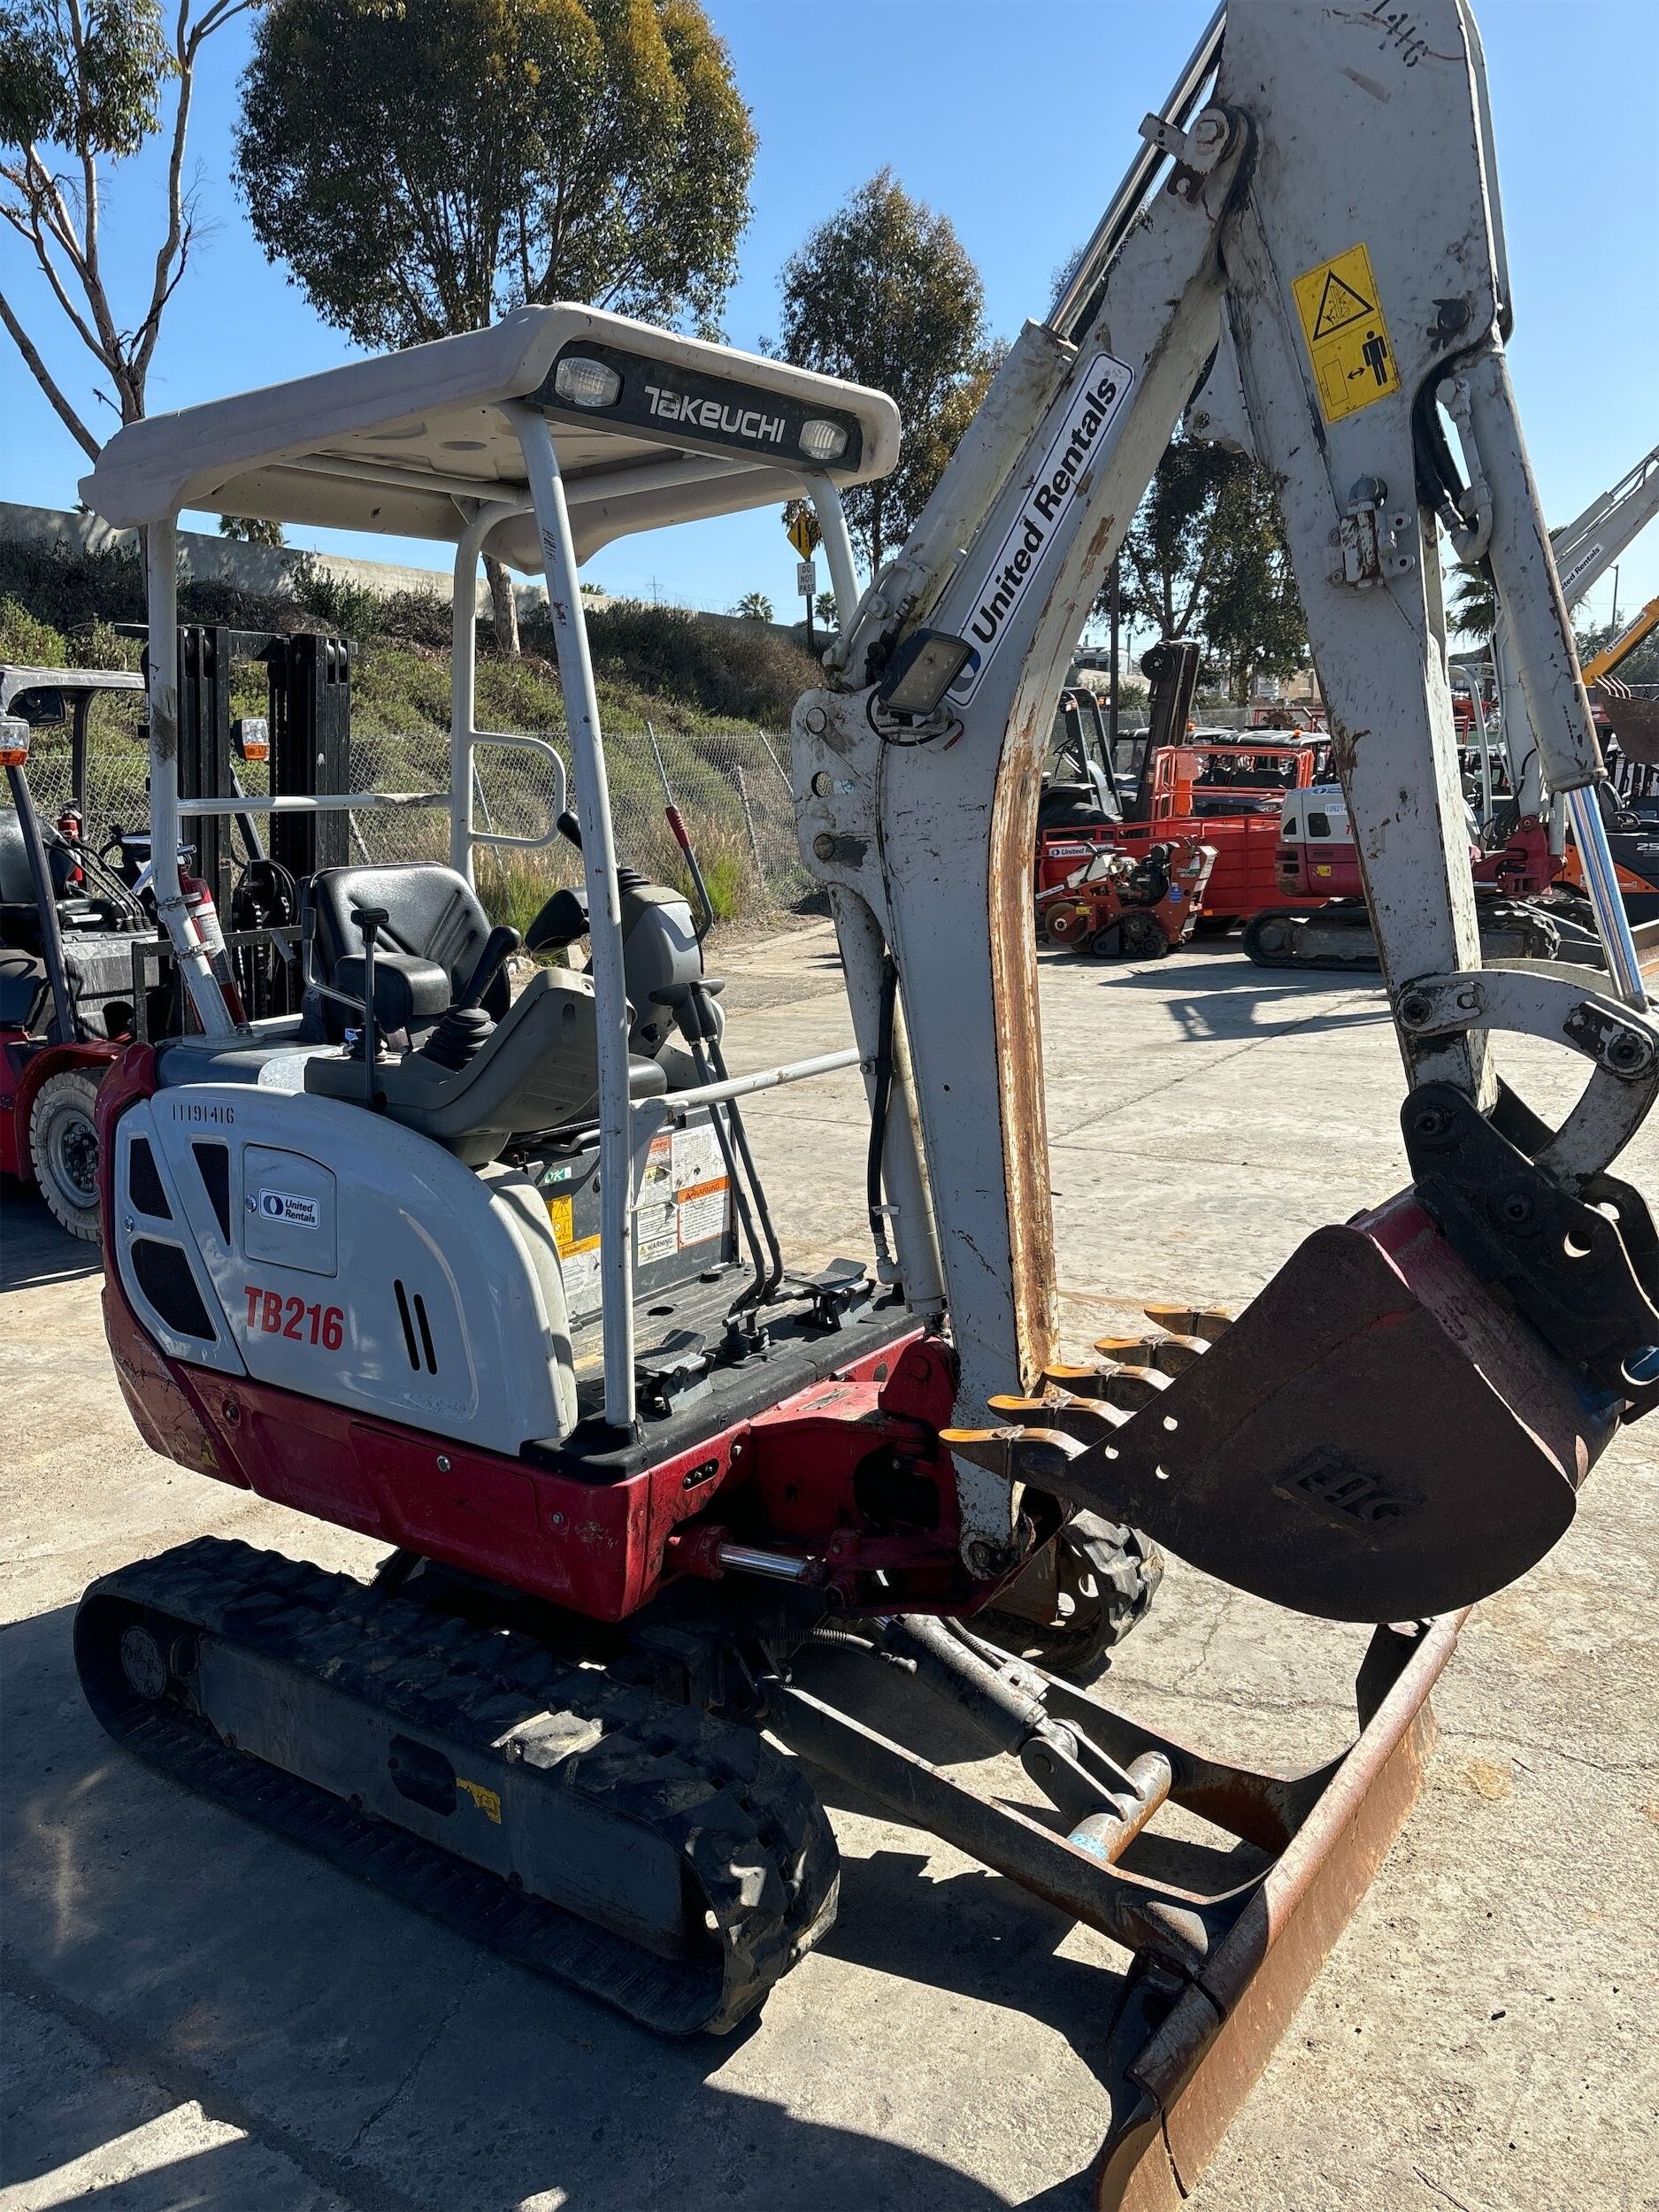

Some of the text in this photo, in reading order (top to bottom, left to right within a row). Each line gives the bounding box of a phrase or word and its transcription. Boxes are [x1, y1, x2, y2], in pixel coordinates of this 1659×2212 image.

[971, 376, 1118, 644] United Rentals
[1561, 546, 1601, 591] ited Rentals
[800, 574, 813, 583] NOT
[799, 584, 815, 593] PASS
[1061, 847, 1084, 856] United
[172, 1103, 234, 1125] 11191416
[285, 1198, 313, 1213] United
[285, 1208, 316, 1225] Rentals
[244, 1285, 344, 1351] TB216
